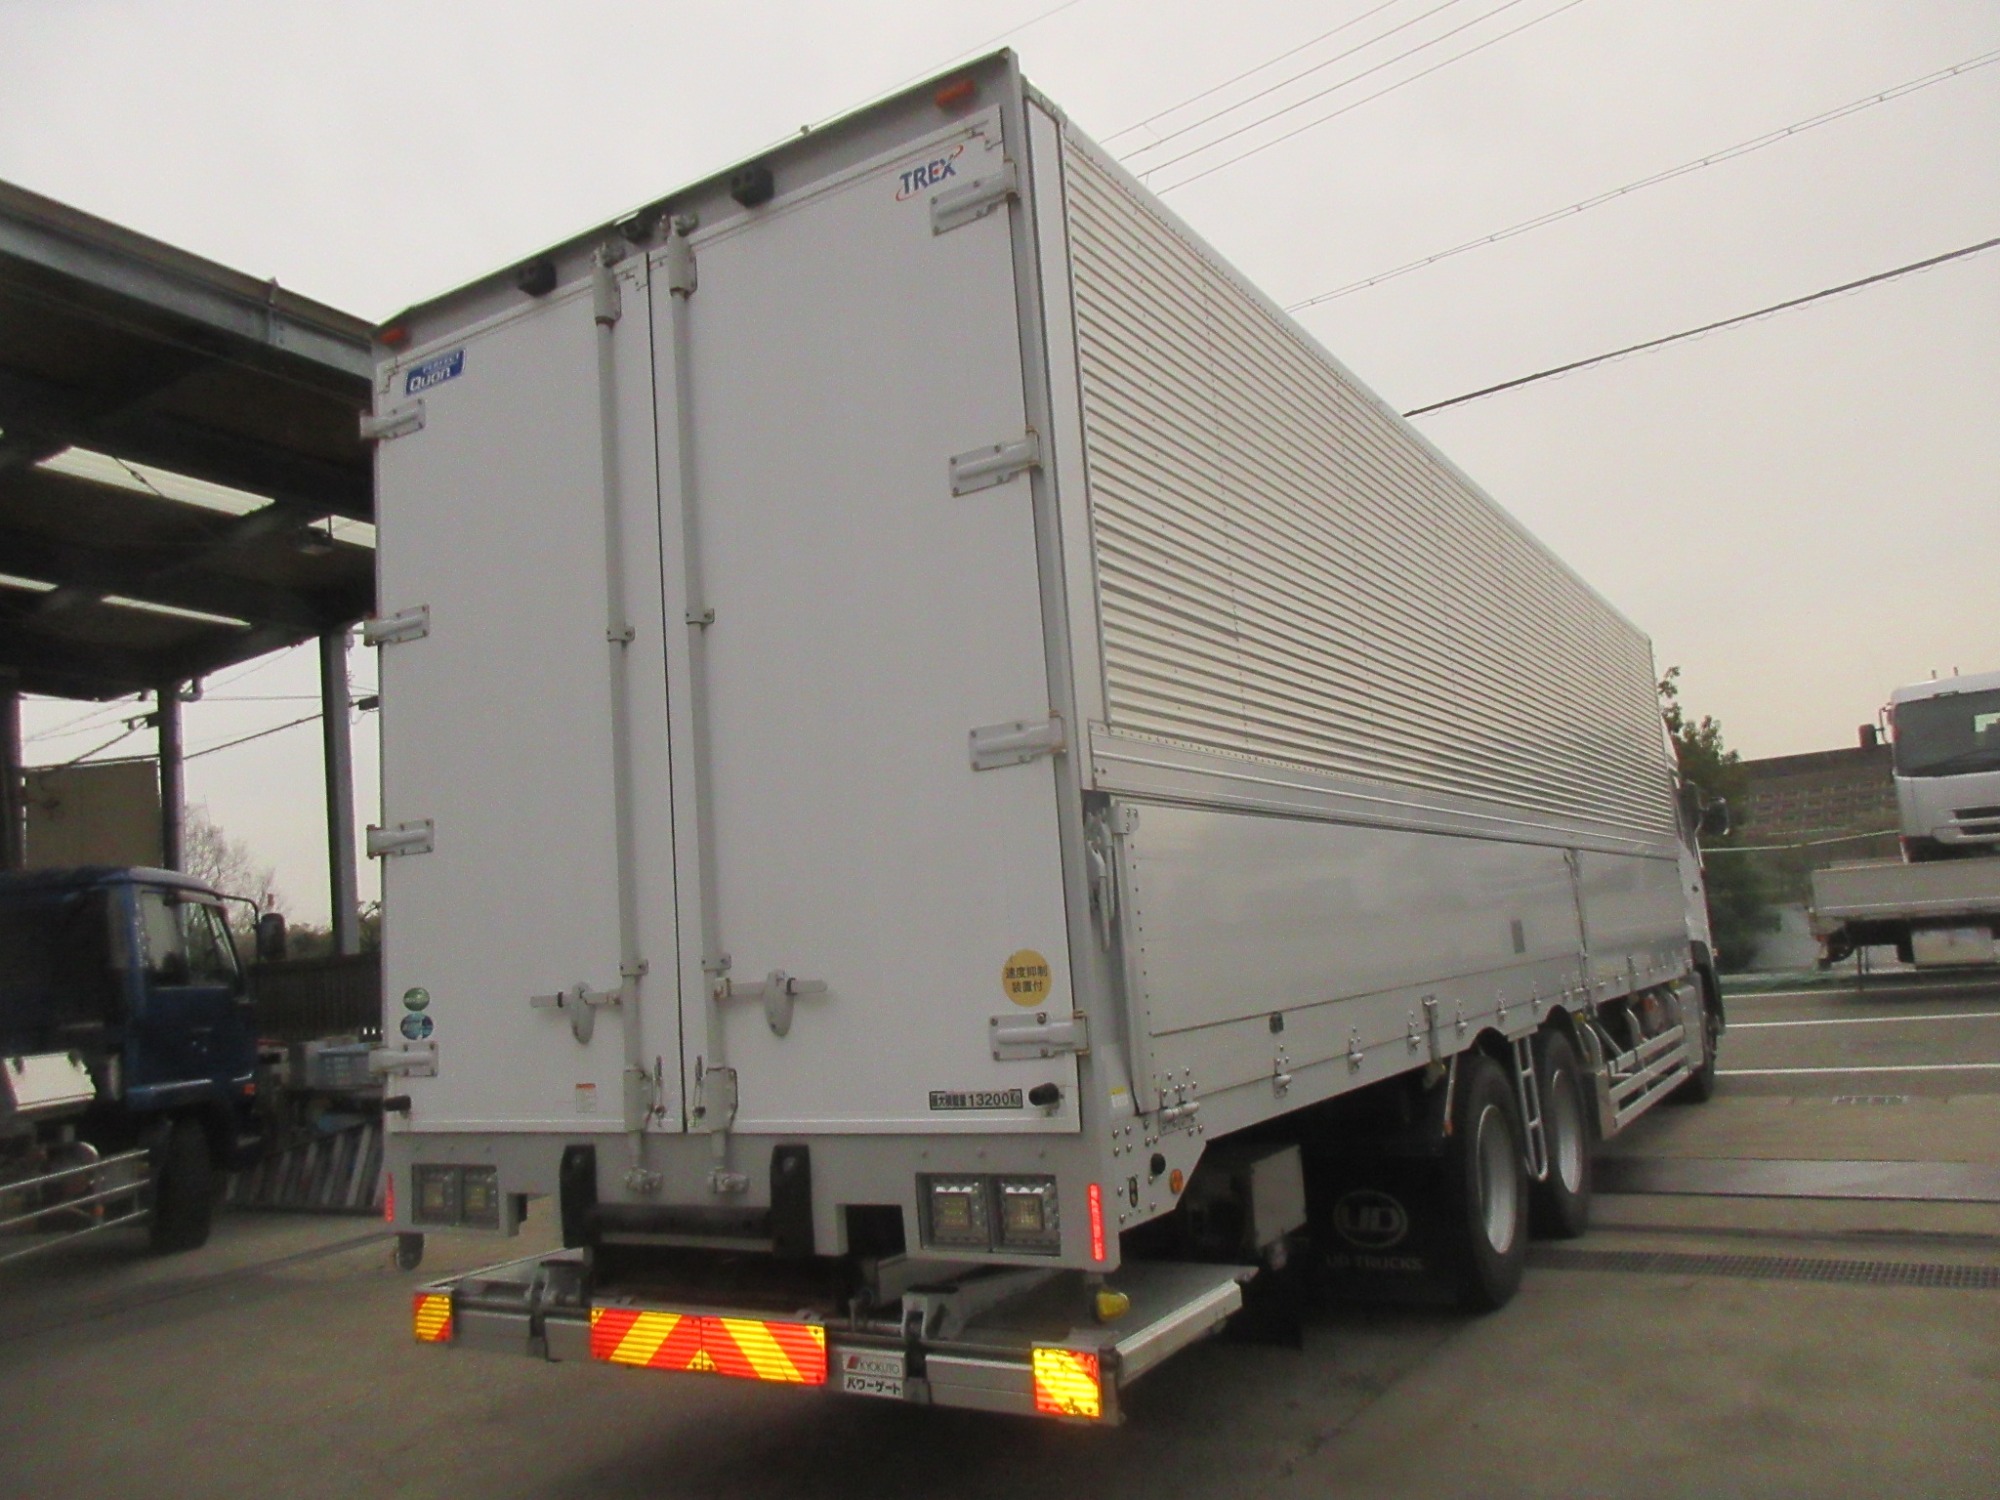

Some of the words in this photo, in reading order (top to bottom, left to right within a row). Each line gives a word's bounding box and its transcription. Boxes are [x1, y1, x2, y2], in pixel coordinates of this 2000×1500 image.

[898, 155, 957, 195] TREX
[409, 366, 451, 391] Quon
[1005, 964, 1048, 979] 速度抑制
[1012, 980, 1043, 993] 装置付
[846, 1376, 901, 1395] パワーゲート
